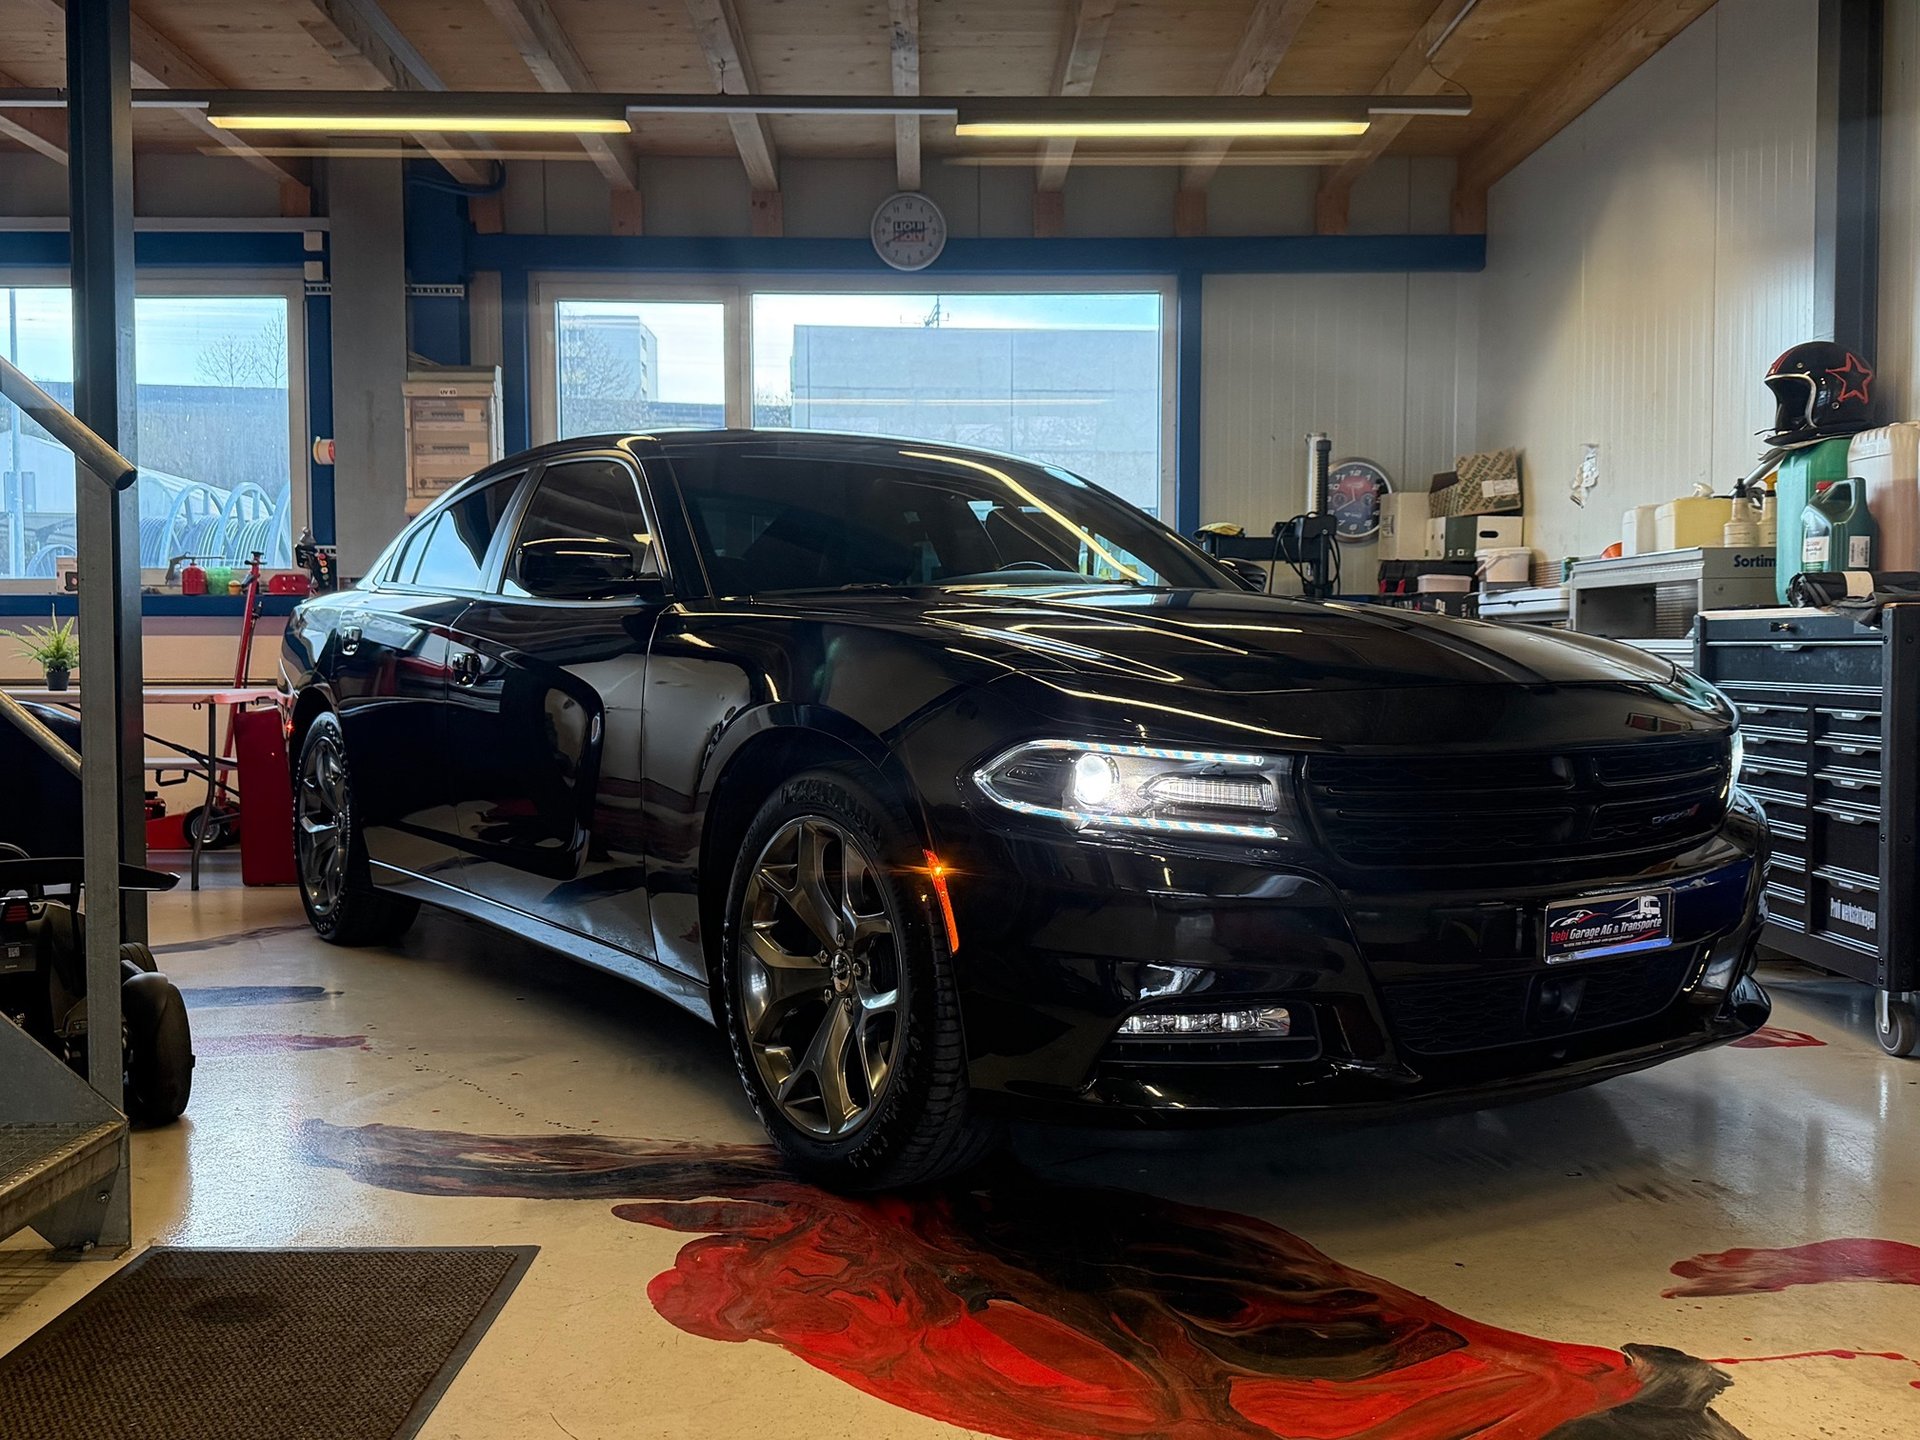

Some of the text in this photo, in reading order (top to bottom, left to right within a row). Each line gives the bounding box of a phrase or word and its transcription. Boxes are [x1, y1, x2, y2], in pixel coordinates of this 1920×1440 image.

[1570, 928, 1600, 940] Garage
[1600, 924, 1613, 936] AG
[1621, 918, 1662, 933] Transporte
